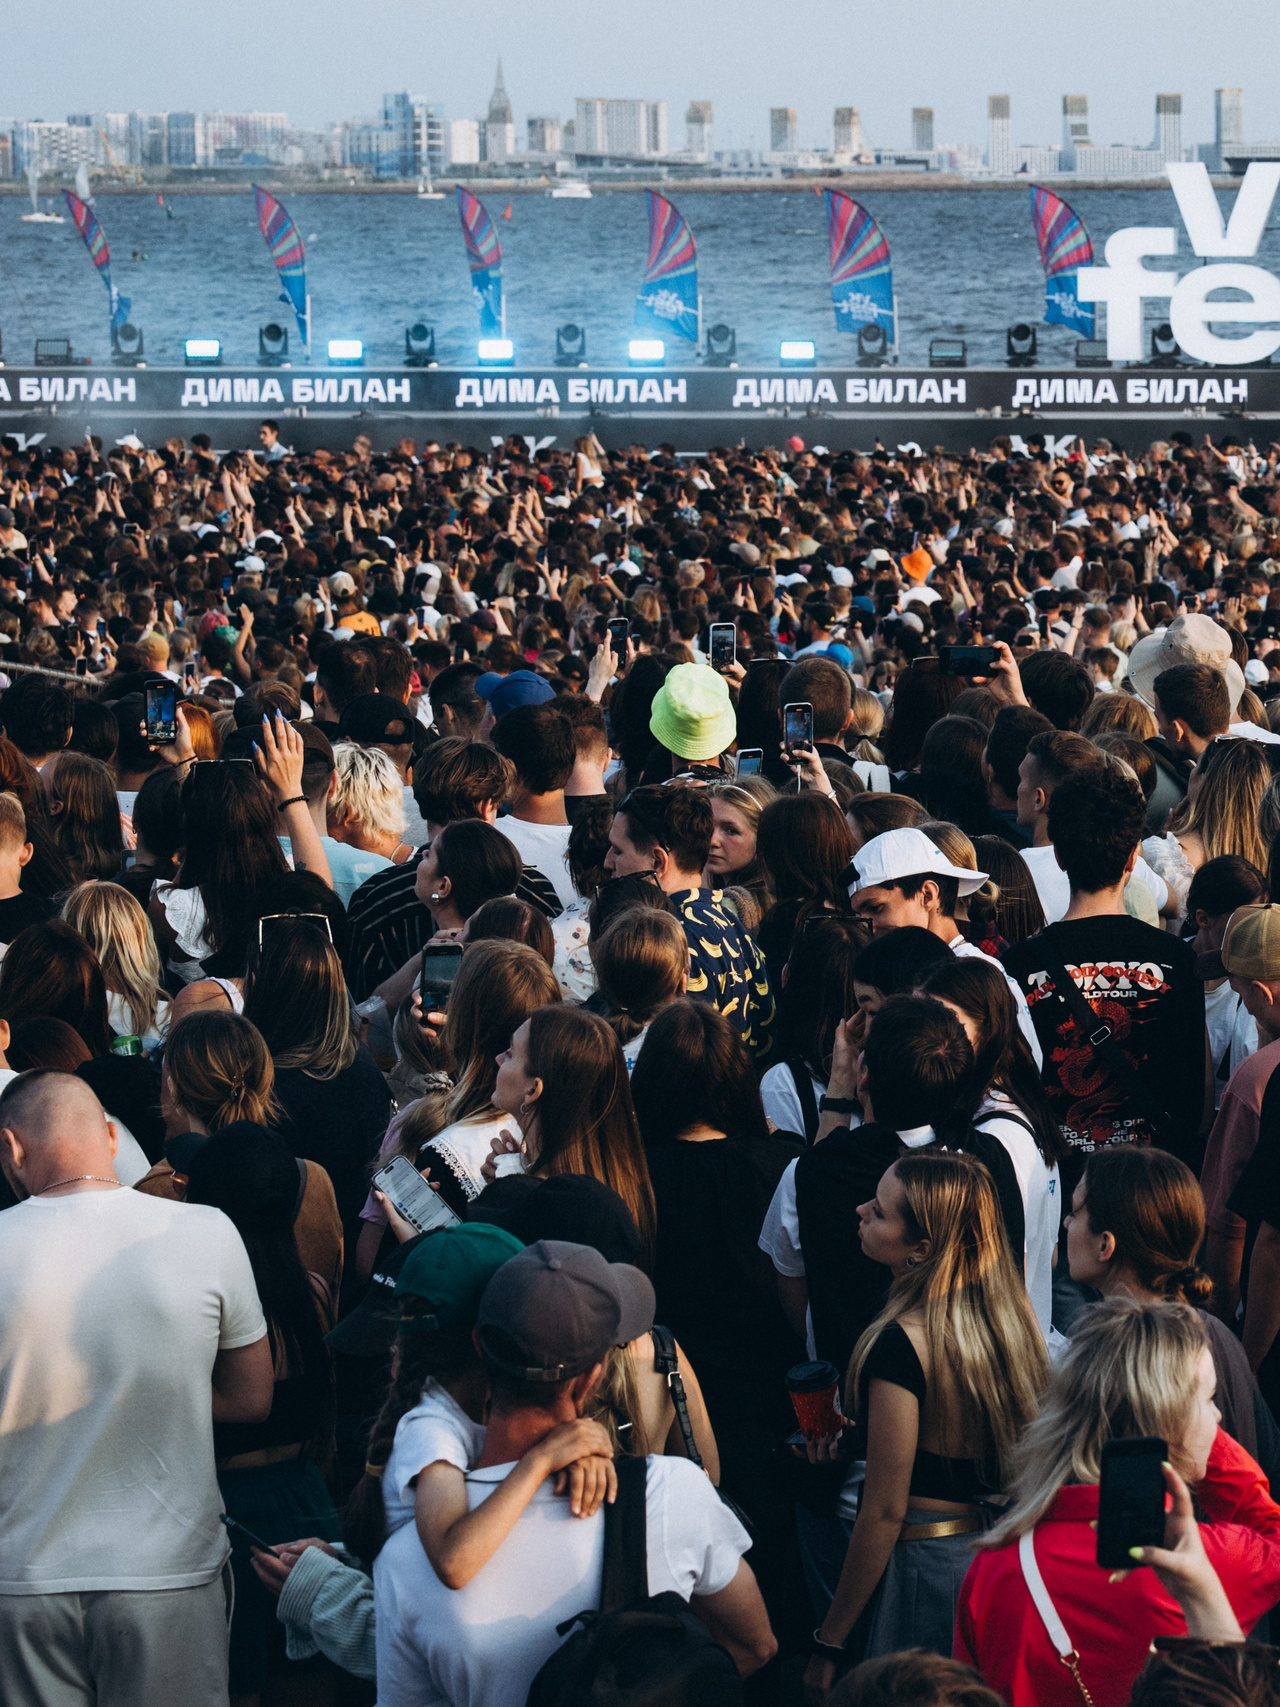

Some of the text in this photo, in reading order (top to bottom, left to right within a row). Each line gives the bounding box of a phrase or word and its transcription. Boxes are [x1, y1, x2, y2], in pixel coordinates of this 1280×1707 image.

[19, 378, 137, 402] БИЛАН
[181, 378, 411, 407] ДИМА БИЛАН
[455, 378, 687, 407] ДИМА БИЛАН
[732, 378, 966, 408] ДИМА БИЛАН
[1011, 378, 1247, 408] ДИМА БИЛАН
[1102, 965, 1173, 994] SOCIETY
